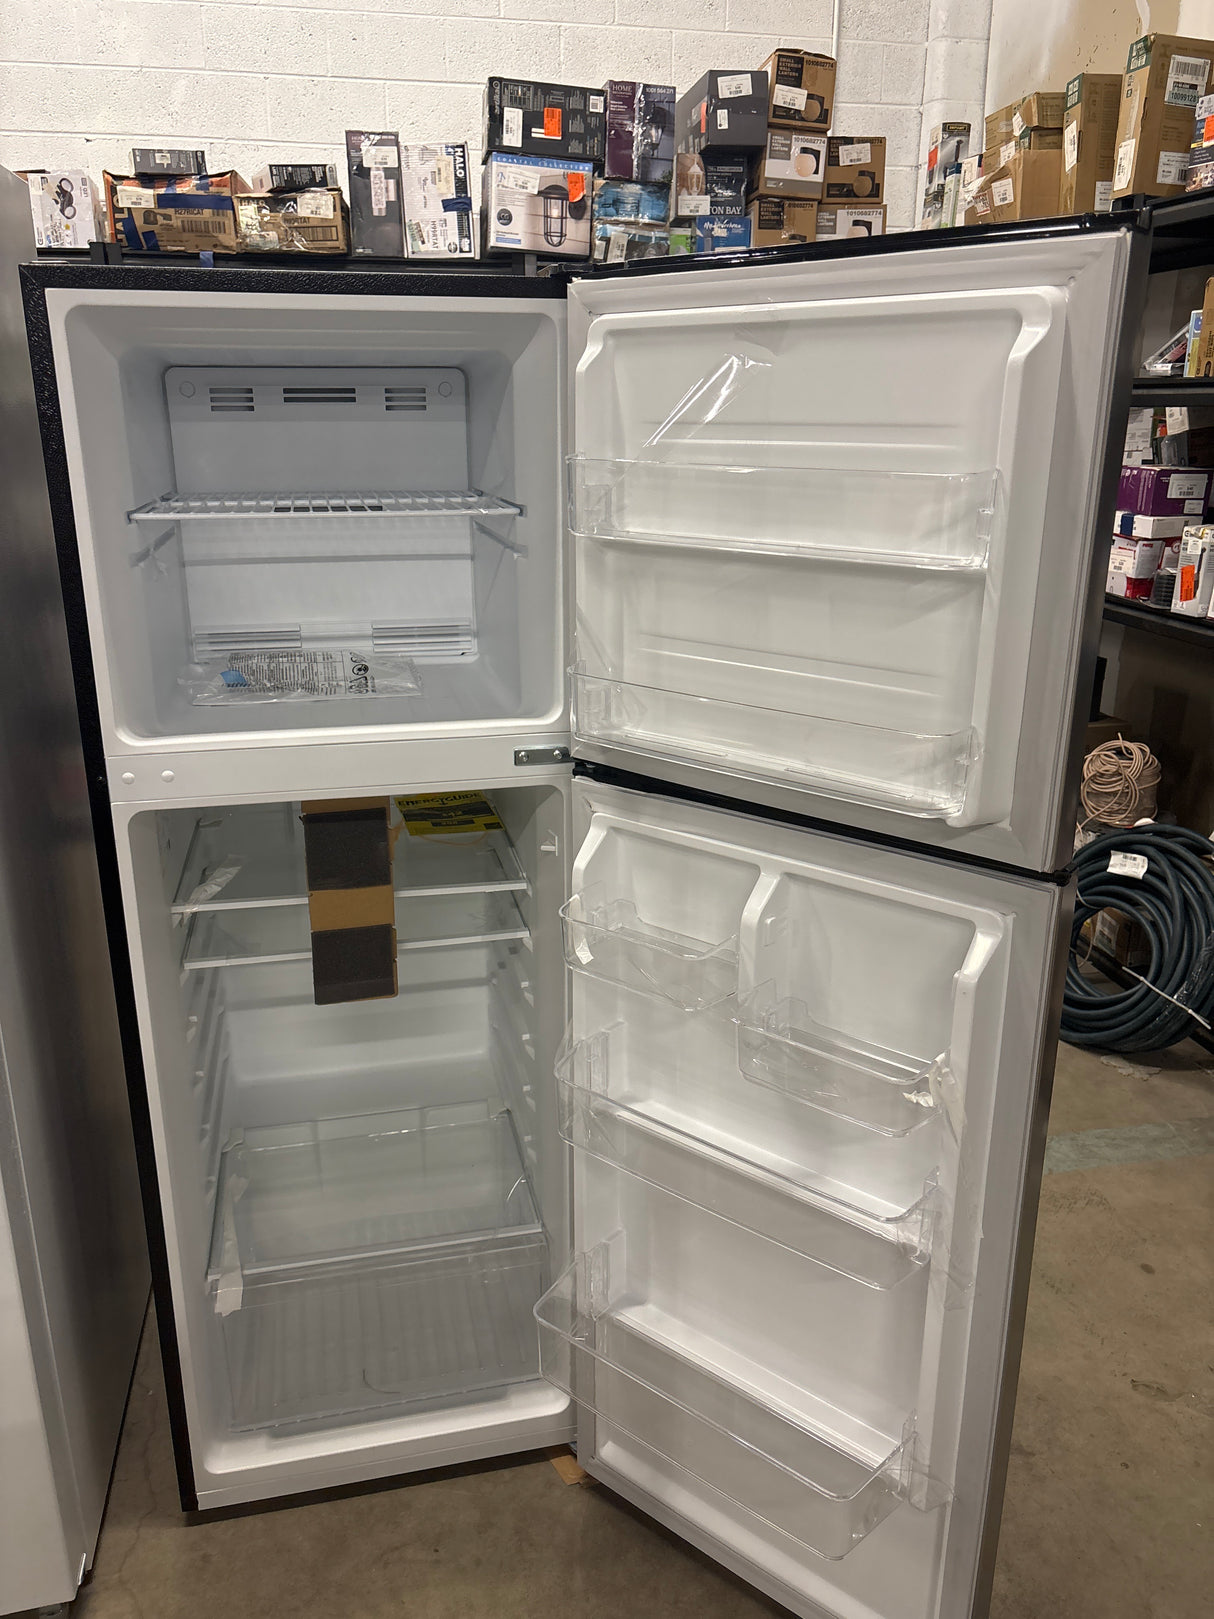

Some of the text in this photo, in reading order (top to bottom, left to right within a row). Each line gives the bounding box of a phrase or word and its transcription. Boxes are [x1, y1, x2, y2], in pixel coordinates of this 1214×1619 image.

[454, 147, 465, 178] HALO
[497, 157, 533, 166] COASTAL
[726, 206, 742, 215] BAY
